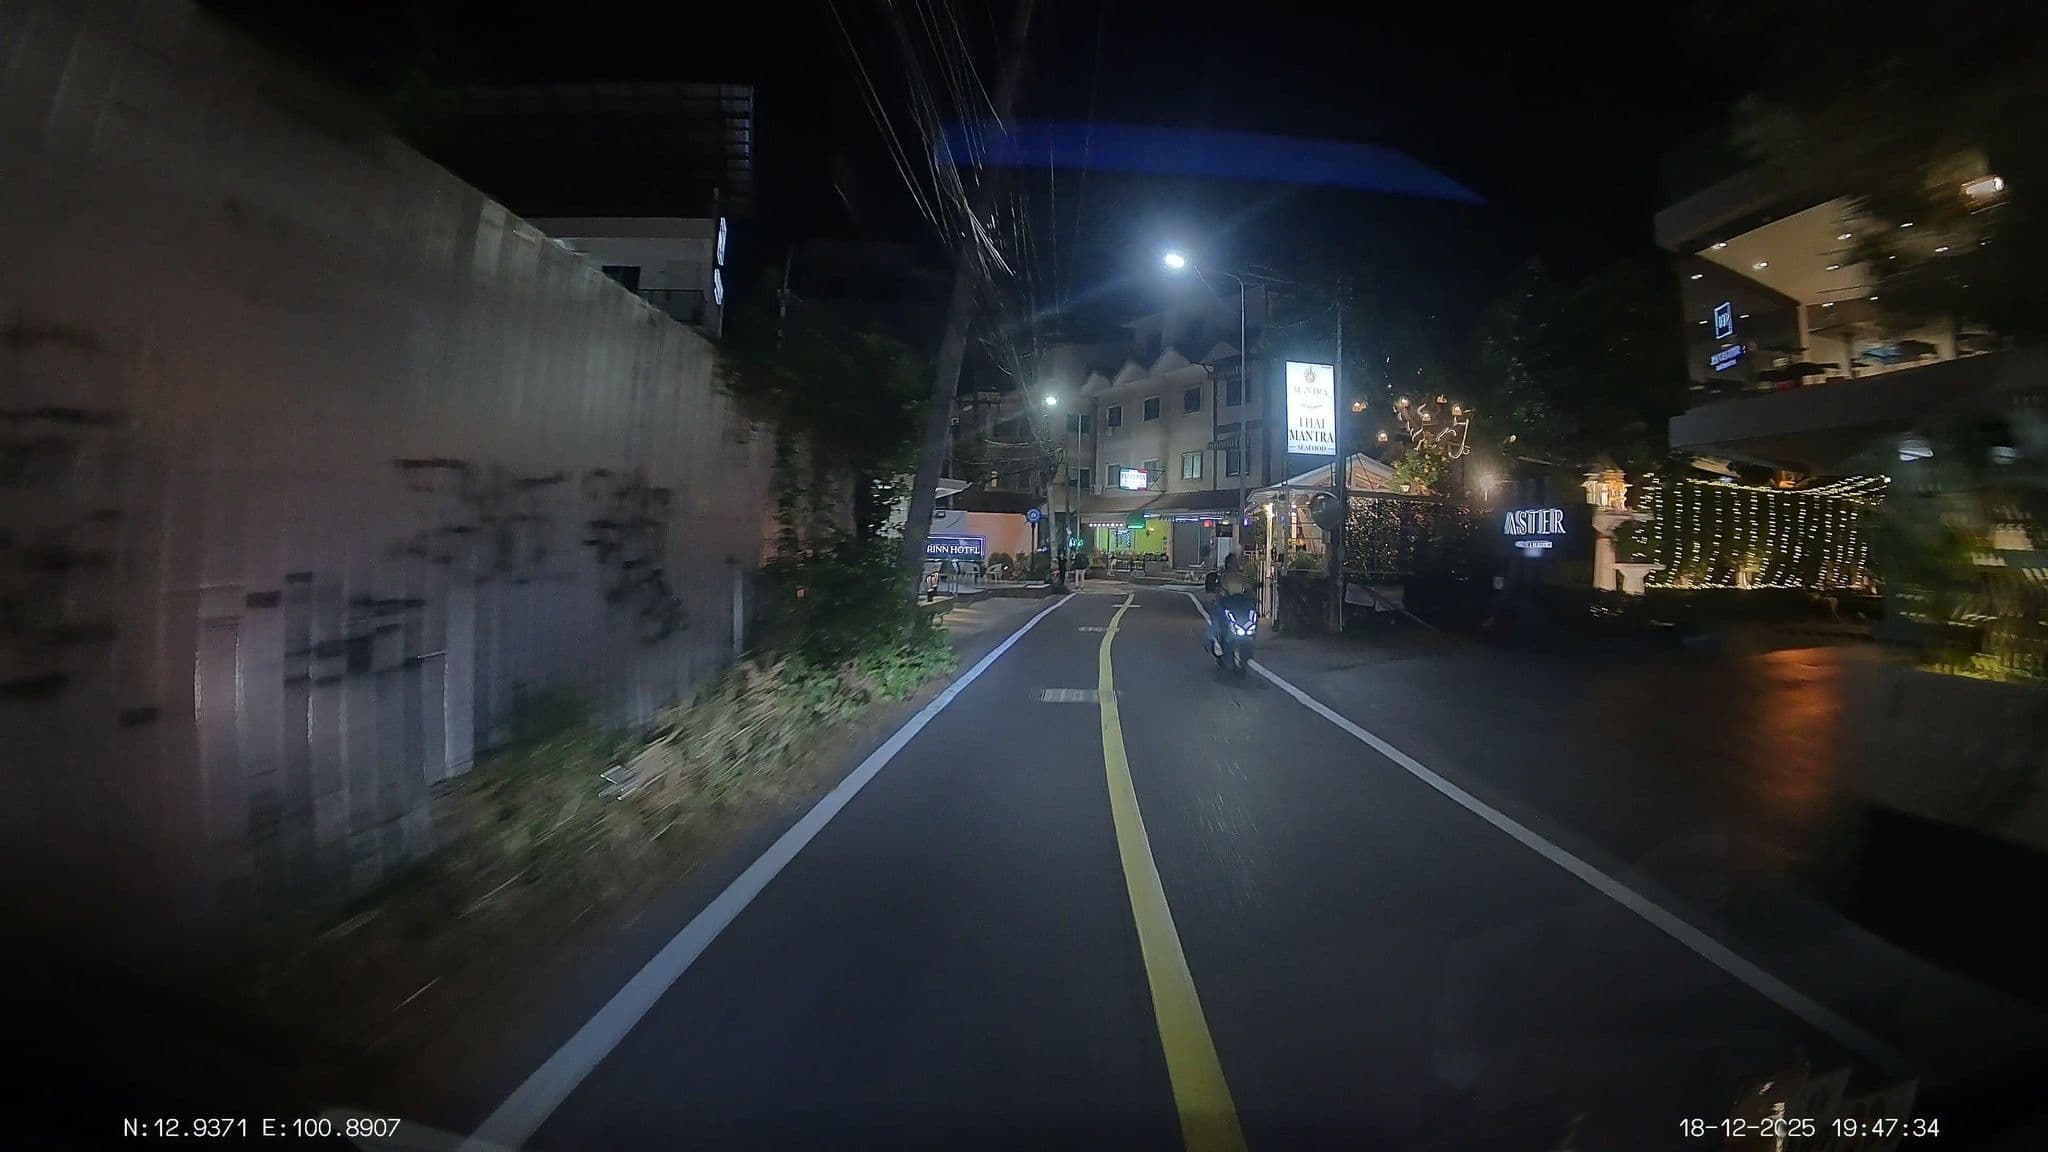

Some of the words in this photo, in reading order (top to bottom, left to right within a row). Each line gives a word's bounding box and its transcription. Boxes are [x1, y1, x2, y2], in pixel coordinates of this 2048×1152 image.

[1299, 416, 1325, 429] THAI
[1289, 429, 1334, 443] MANTRA
[1297, 444, 1327, 452] SEAFOOD
[1504, 509, 1566, 535] ASTER
[950, 545, 981, 554] HOTEL
